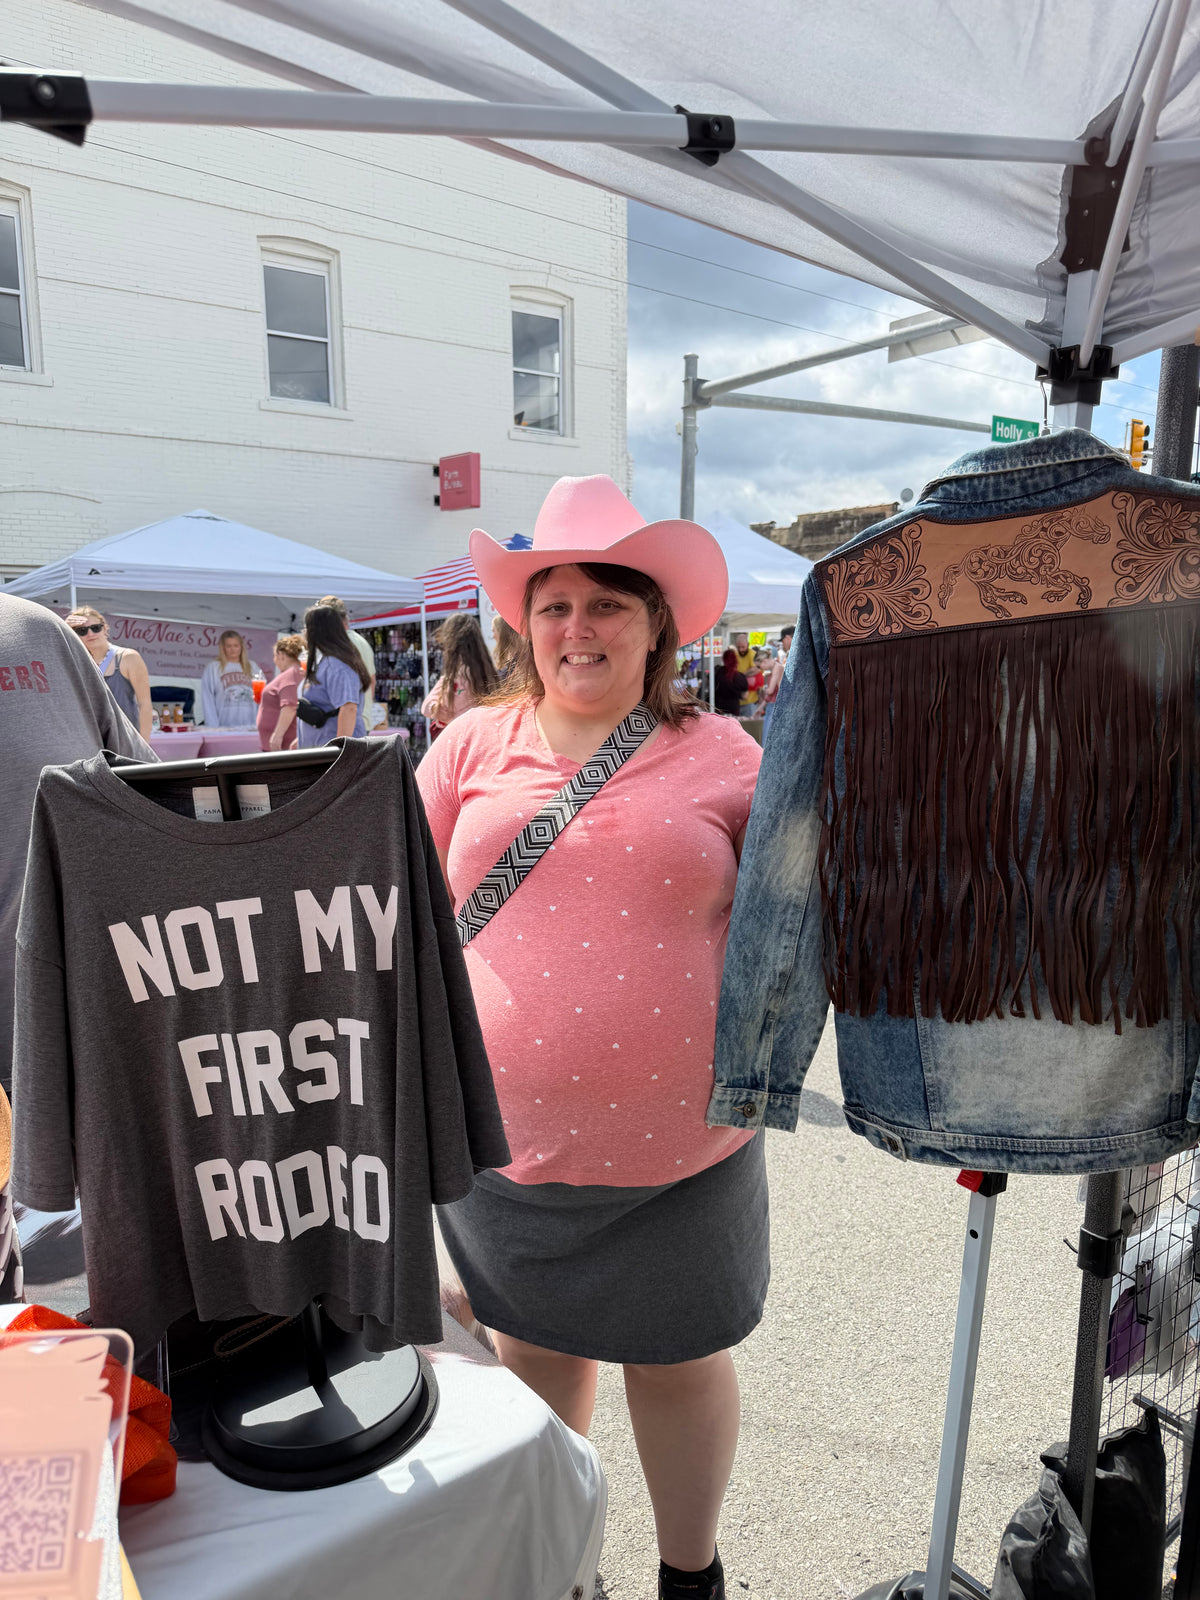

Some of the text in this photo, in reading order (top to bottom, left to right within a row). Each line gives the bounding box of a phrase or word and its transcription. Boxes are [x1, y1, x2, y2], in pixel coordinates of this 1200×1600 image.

[996, 421, 1023, 441] Holly
[113, 619, 195, 645] NaeNae's
[0, 660, 51, 693] ERS
[109, 884, 399, 1004] NOT MY
[178, 1018, 370, 1117] FIRST
[194, 1146, 390, 1243] RODEO
